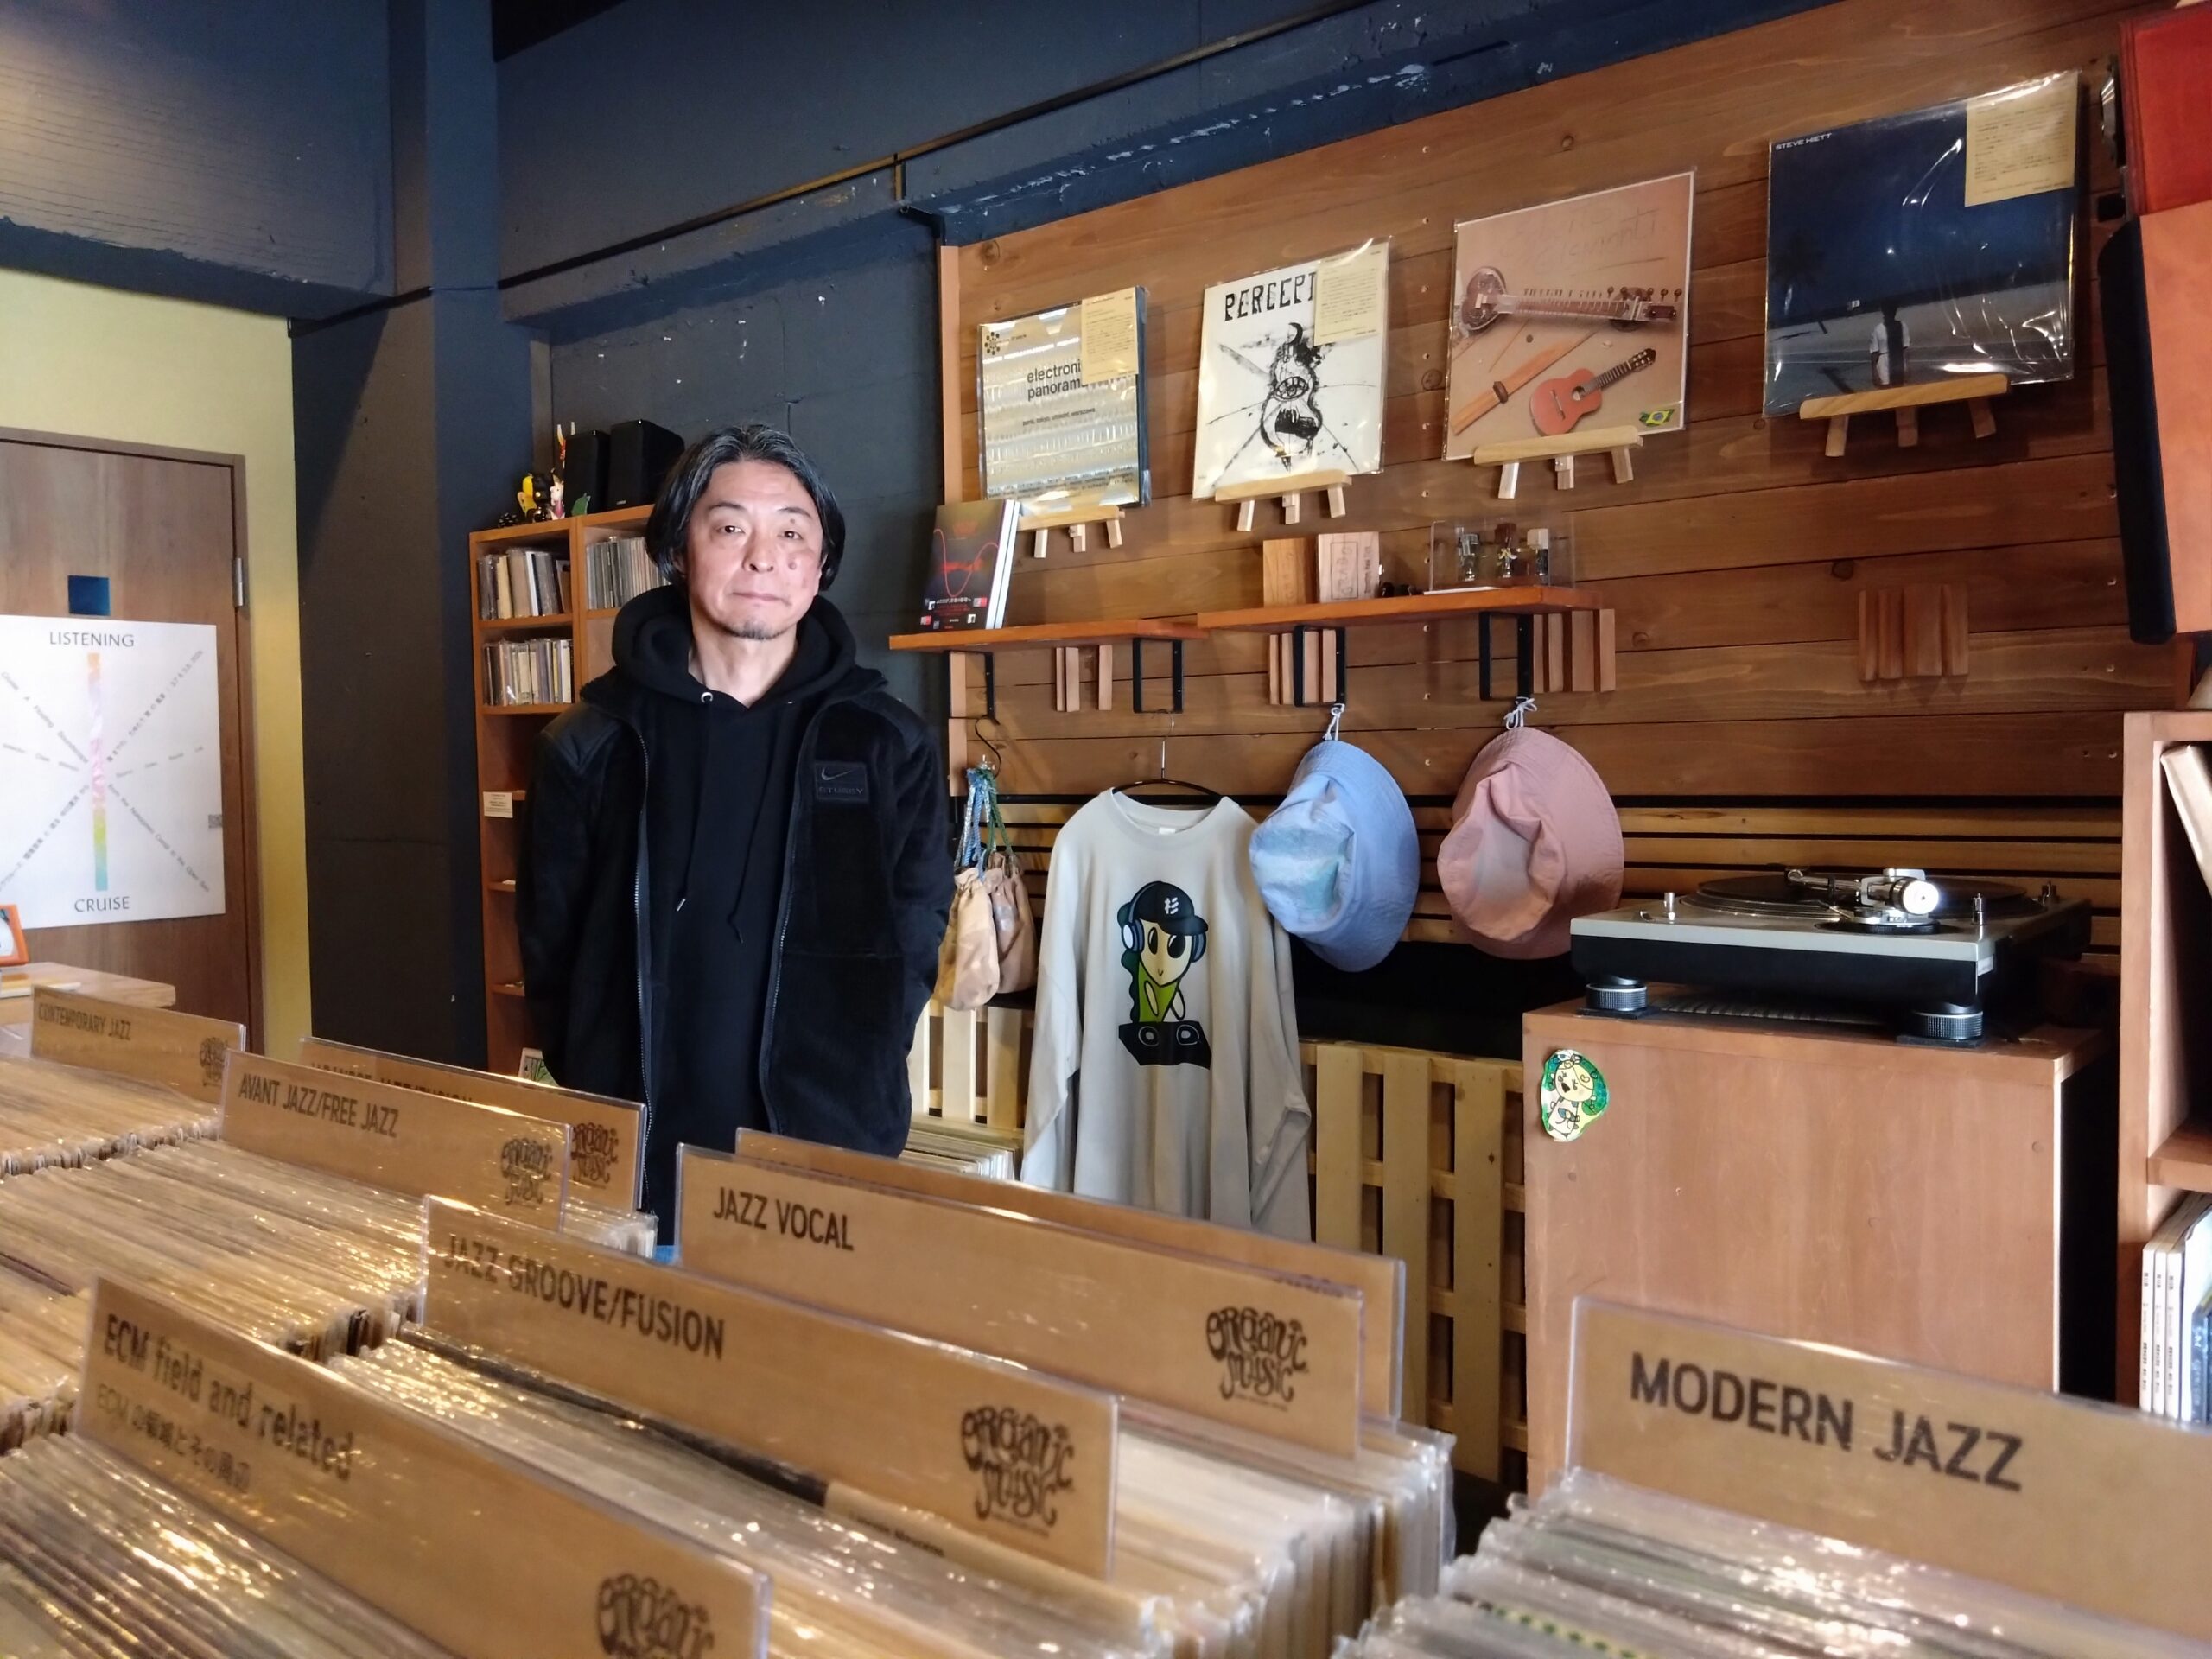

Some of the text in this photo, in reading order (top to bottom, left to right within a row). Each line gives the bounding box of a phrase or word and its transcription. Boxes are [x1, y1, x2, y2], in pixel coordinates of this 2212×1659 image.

[1776, 139, 1804, 150] STEVE
[1027, 359, 1081, 384] electroni
[49, 632, 135, 648] LISTENING
[74, 896, 130, 912] CRUISE
[39, 1002, 131, 1041] CONTEMPORARY JAZZ
[238, 1073, 280, 1107] AVANT
[283, 1084, 358, 1127] JAZZ/FREE
[361, 1103, 399, 1138] JAZZ
[713, 1187, 855, 1251] JAZZ VOCAL
[444, 1236, 724, 1360] JAZZ GROOVE/FUSION
[105, 1313, 354, 1481] ECM field and related
[1630, 1351, 2023, 1492] MODERN JAZZ
